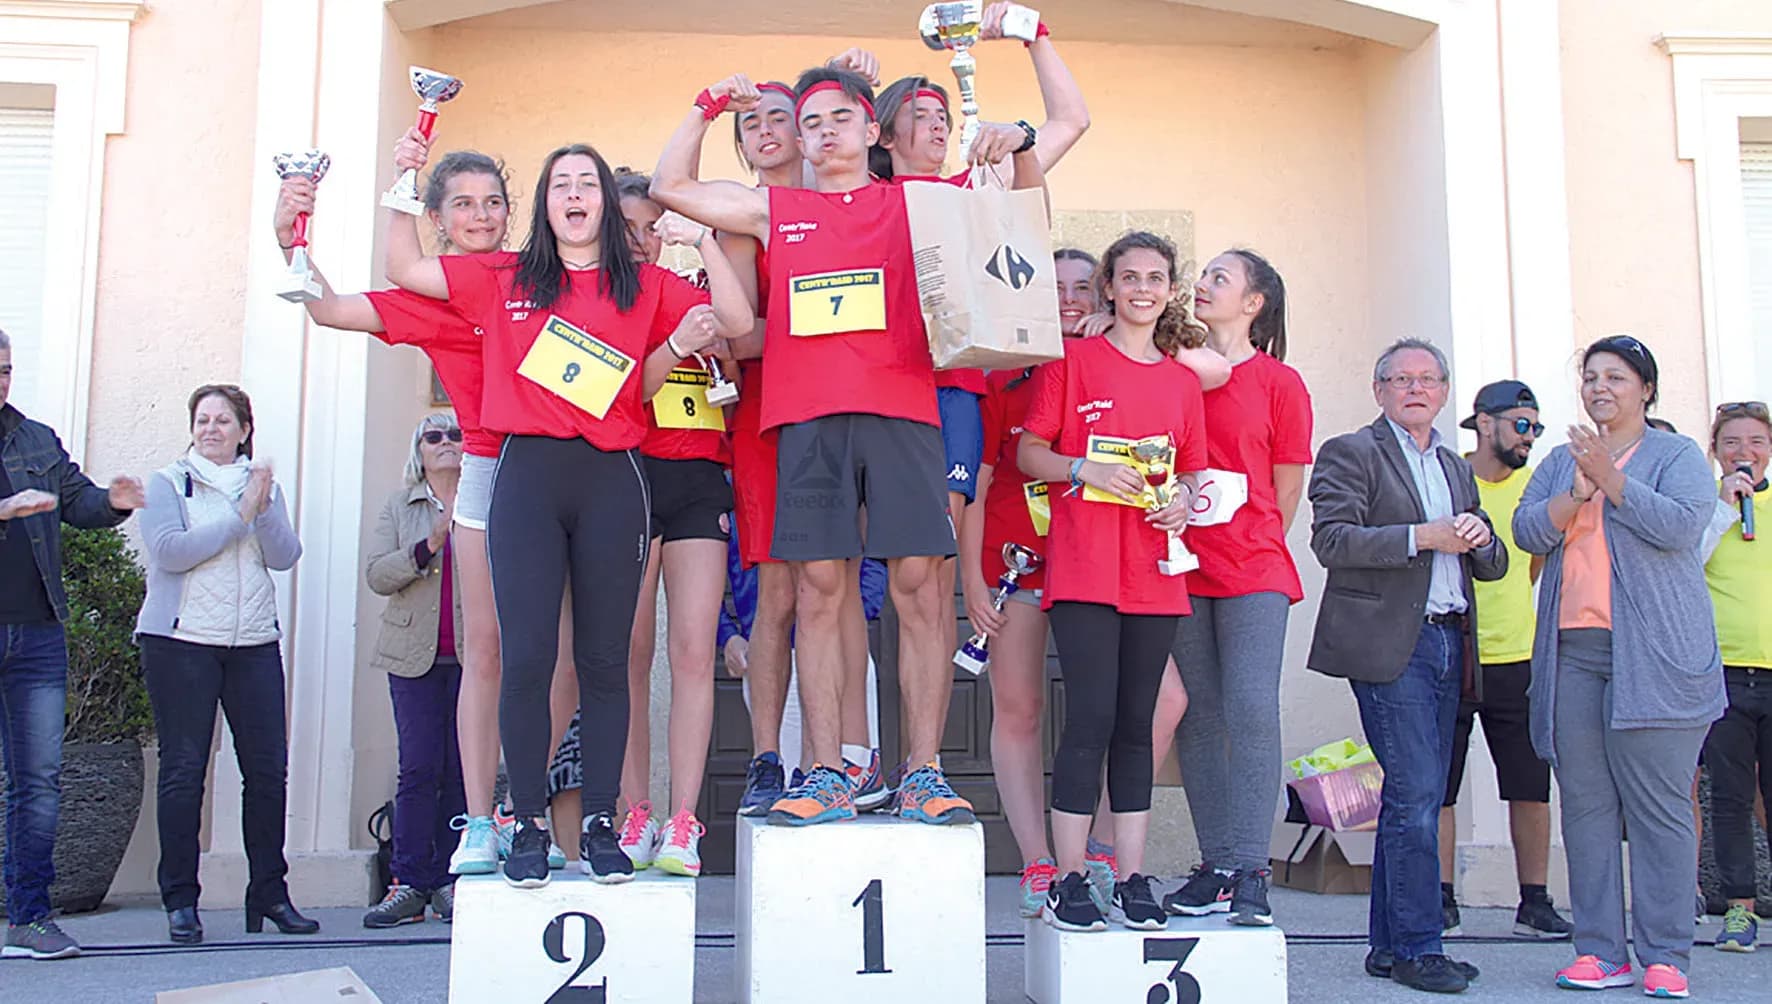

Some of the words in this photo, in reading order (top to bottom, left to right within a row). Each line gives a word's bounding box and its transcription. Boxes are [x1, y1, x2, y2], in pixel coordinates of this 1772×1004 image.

[785, 233, 806, 243] 2017
[854, 273, 875, 283] 2017
[511, 311, 529, 321] 2017
[829, 295, 844, 316] 7
[562, 362, 581, 383] 8
[682, 396, 696, 416] 8
[1085, 411, 1101, 423] 2017
[1192, 480, 1215, 513] 6
[852, 878, 893, 975] 1
[542, 911, 607, 1004] 2
[1143, 937, 1202, 1004] 3
